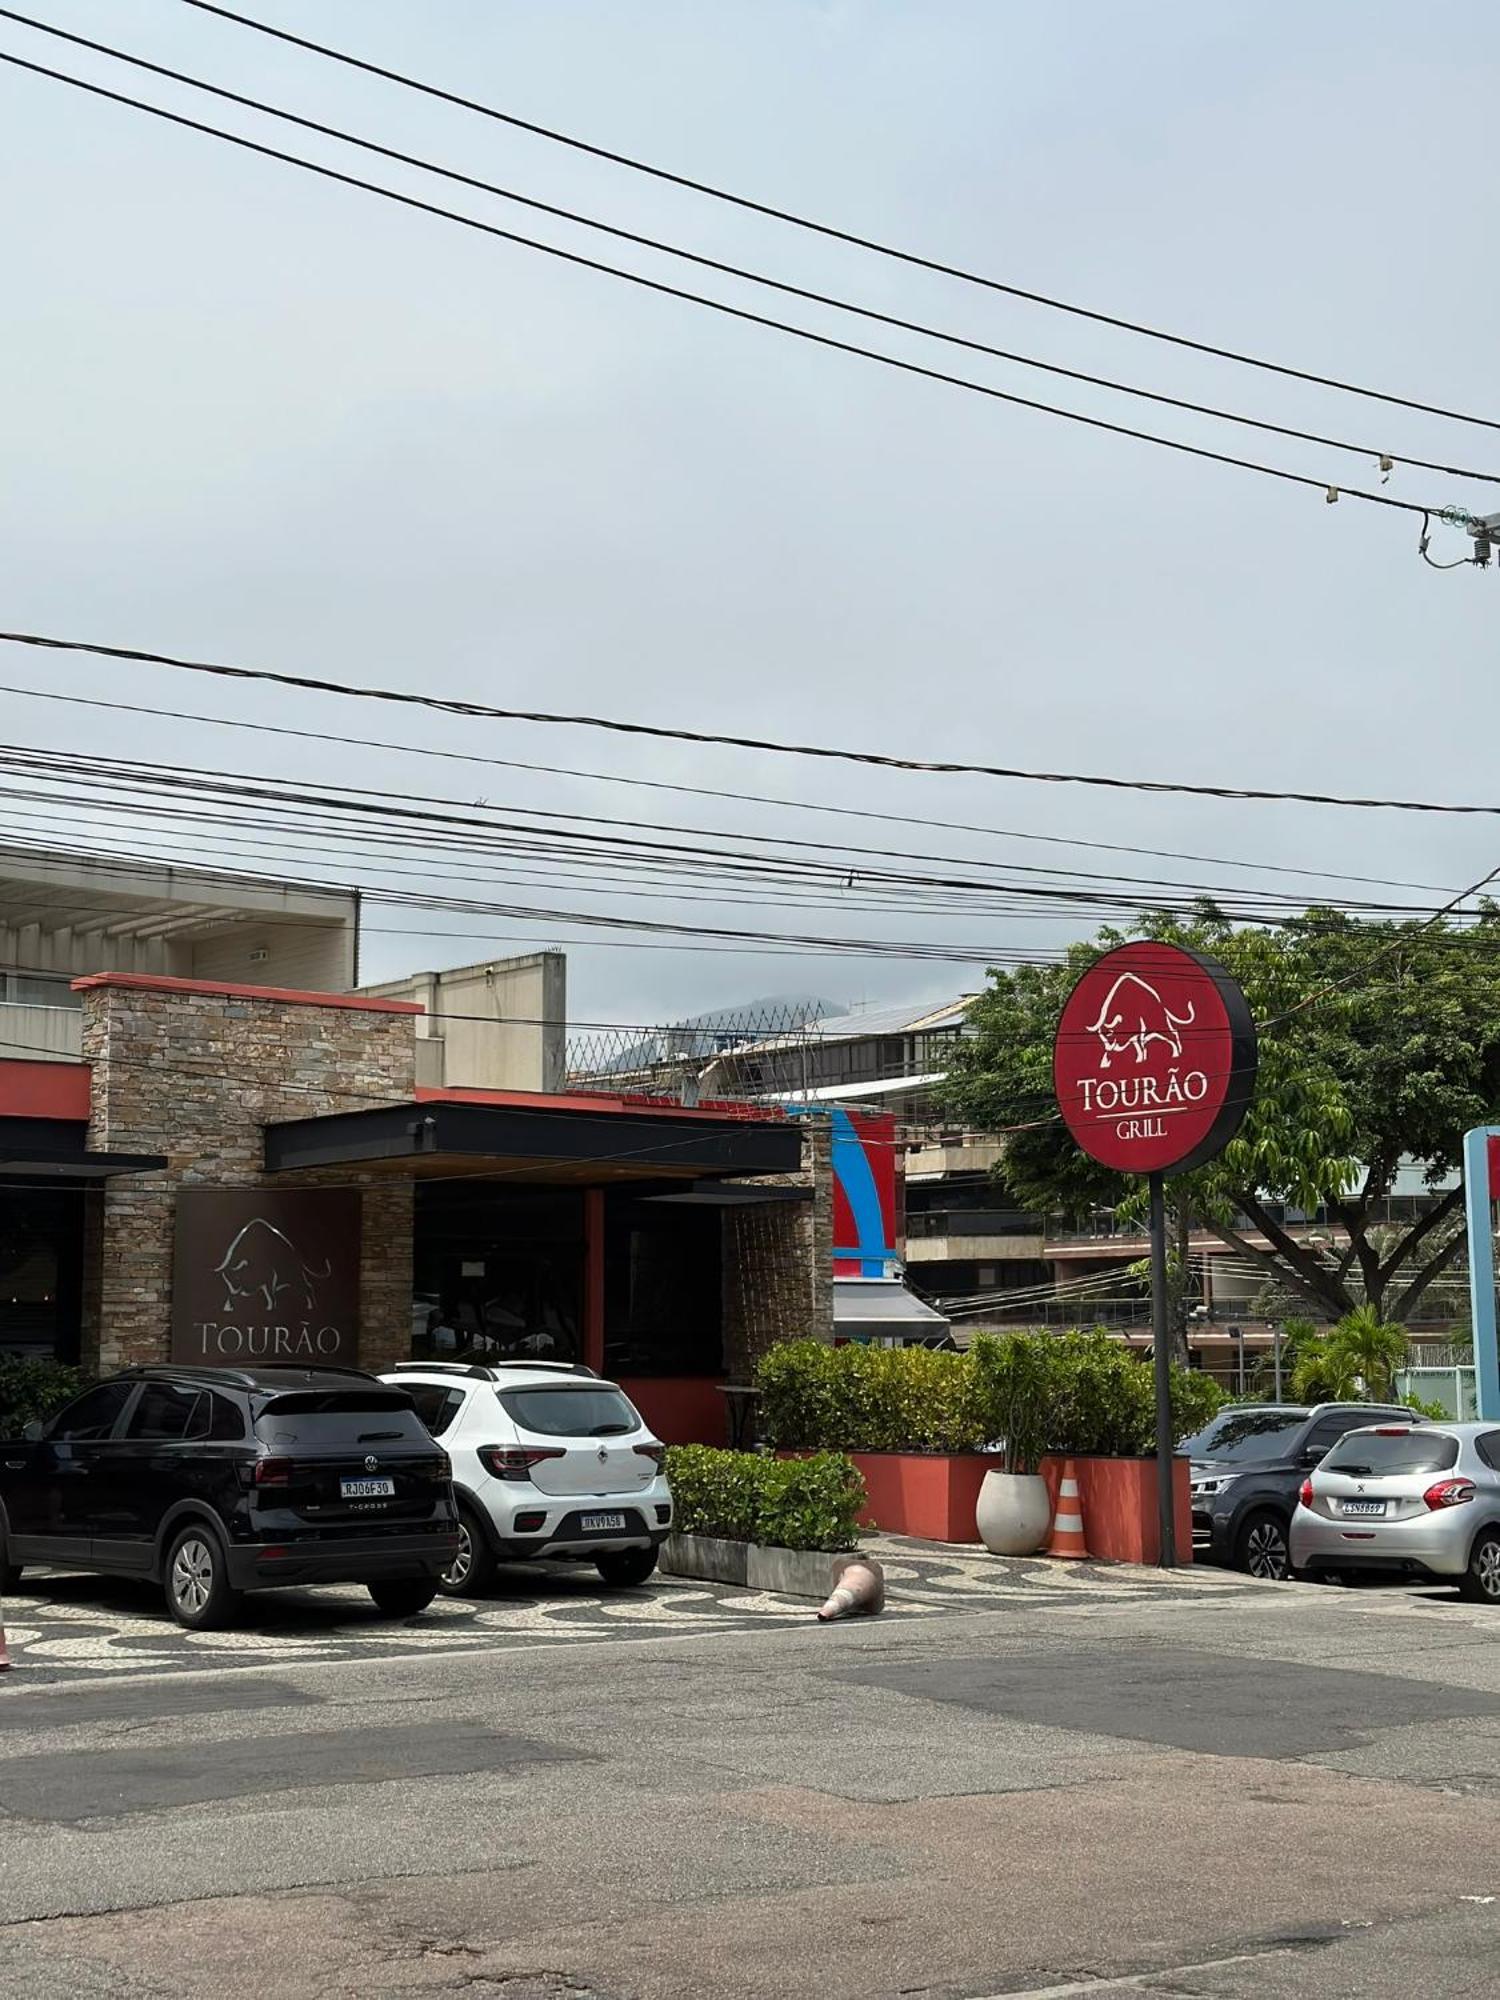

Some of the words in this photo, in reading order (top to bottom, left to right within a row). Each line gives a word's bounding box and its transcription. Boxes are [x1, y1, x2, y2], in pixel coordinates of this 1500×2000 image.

[1077, 1067, 1208, 1111] TOURÃO
[1116, 1118, 1168, 1140] GRILL
[193, 1321, 341, 1354] TOURÃO
